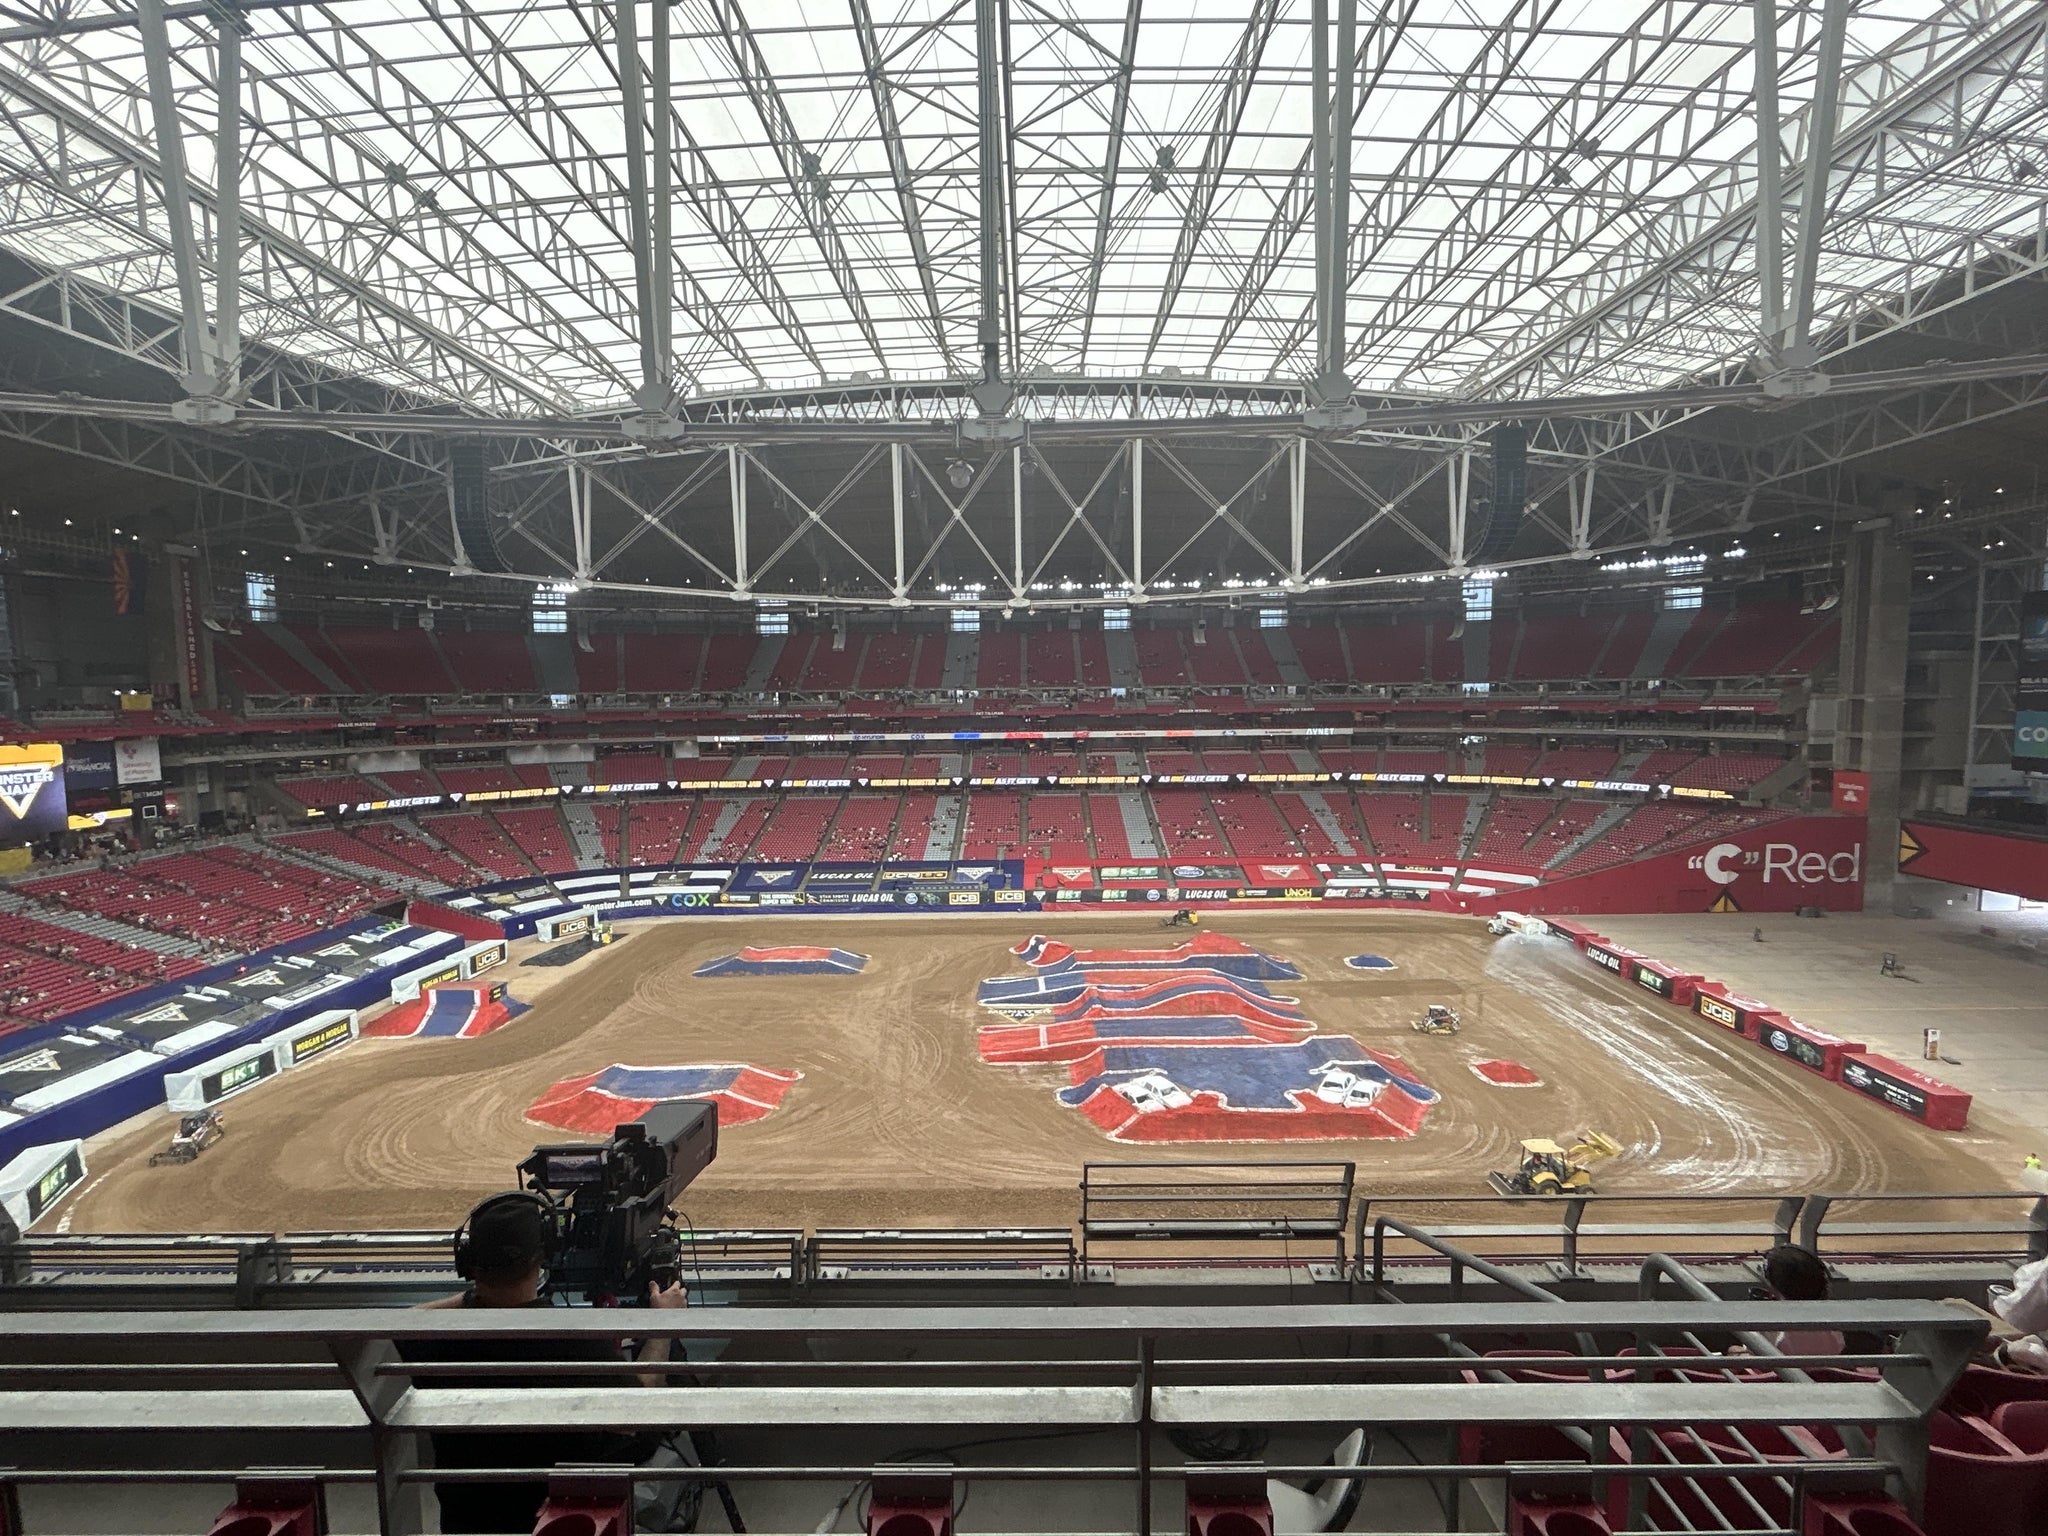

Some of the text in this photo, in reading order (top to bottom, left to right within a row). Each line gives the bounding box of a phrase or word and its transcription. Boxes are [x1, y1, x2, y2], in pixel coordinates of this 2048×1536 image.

[0, 771, 55, 786] NSTER
[1763, 843, 1861, 883] Red
[811, 872, 852, 880] LUCAS
[671, 893, 710, 907] COX
[852, 893, 880, 903] LUCAS
[880, 893, 895, 903] OIL
[951, 894, 977, 903] JCB
[996, 892, 1023, 901] JCB
[1185, 889, 1228, 899] LUCAS OIL
[1284, 888, 1312, 898] UNOH
[583, 898, 652, 911] MonsterJam.com
[561, 919, 587, 934] JCB
[478, 950, 499, 967] JCB
[1587, 946, 1620, 971] LUCAS OIL
[1703, 1001, 1733, 1023] JCB
[296, 1037, 321, 1054] MORGAN
[325, 1023, 348, 1040] MORGAN
[221, 1060, 260, 1089] BKT
[41, 1163, 68, 1202] BKT
